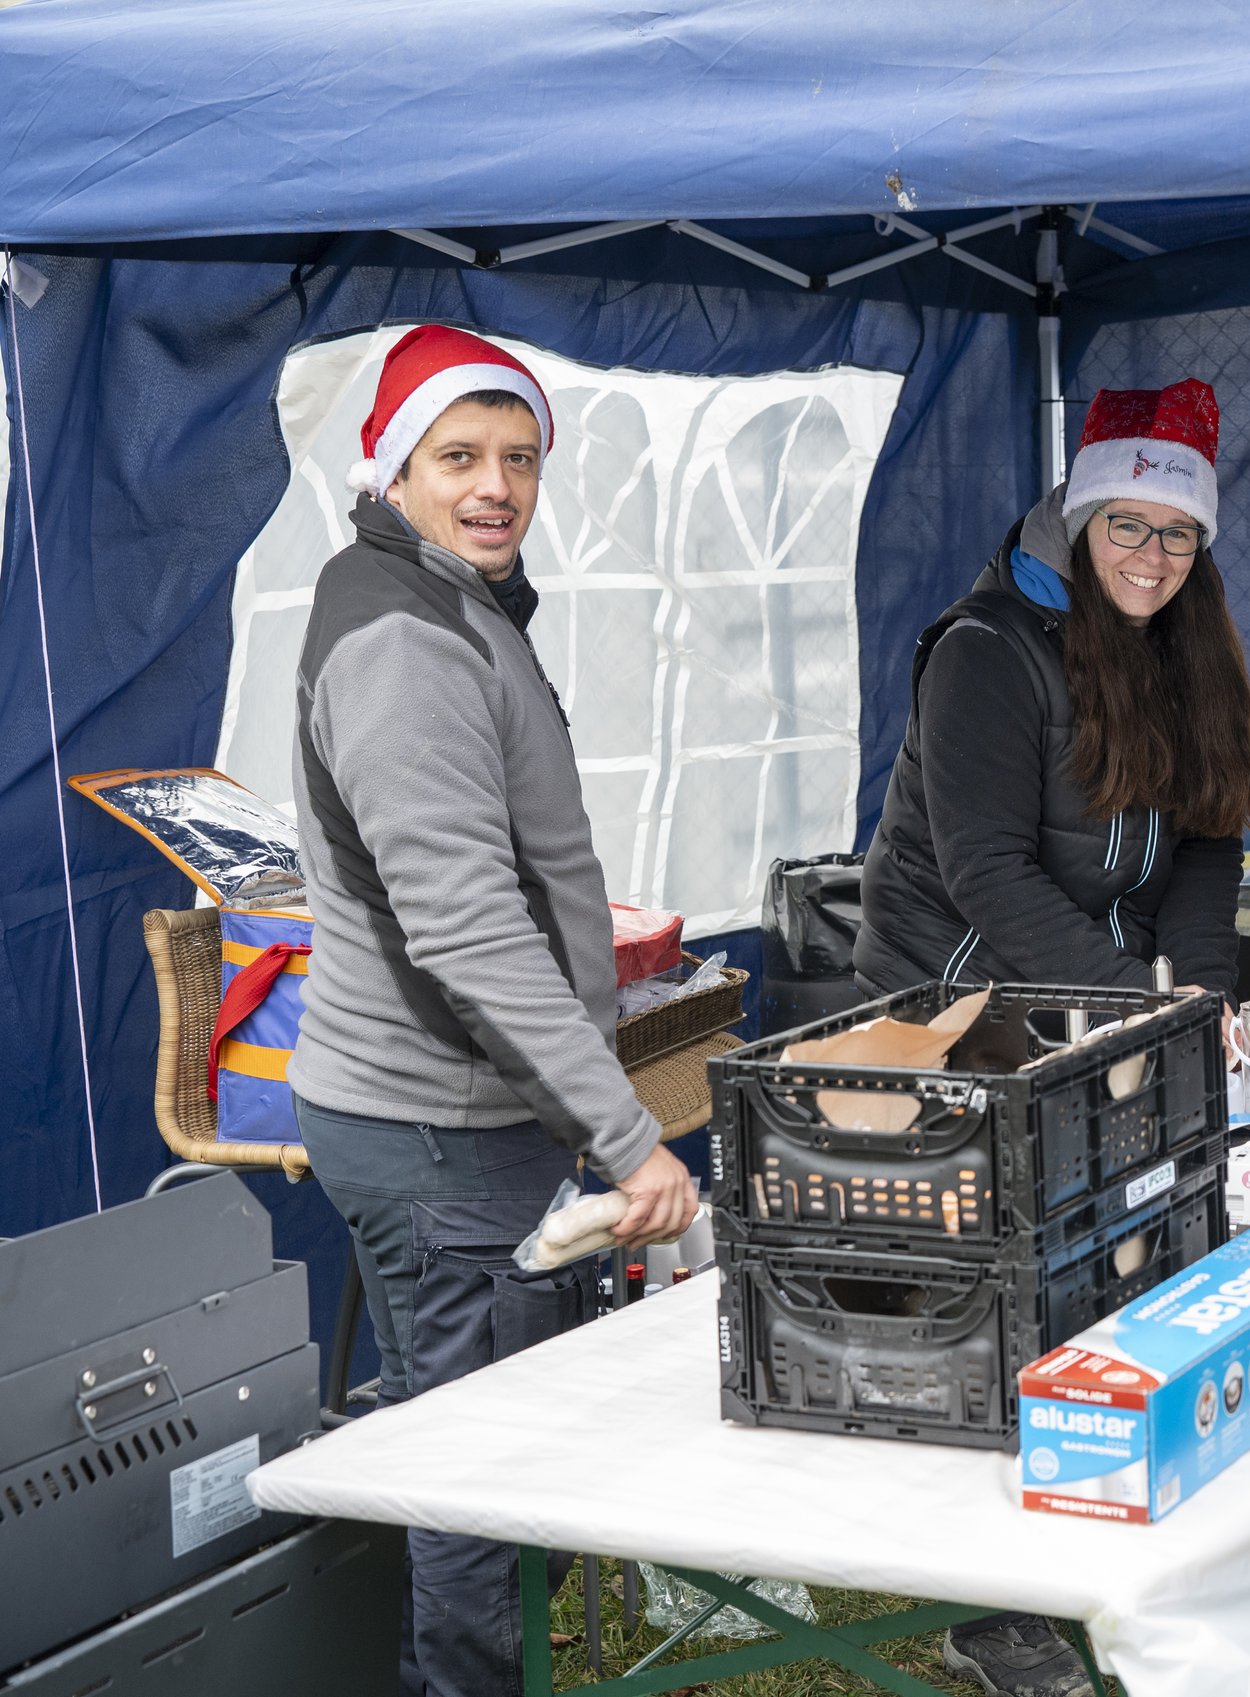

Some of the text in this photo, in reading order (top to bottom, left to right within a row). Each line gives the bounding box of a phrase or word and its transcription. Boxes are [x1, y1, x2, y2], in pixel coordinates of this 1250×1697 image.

[1066, 1388, 1113, 1404] SOLIDE
[1029, 1405, 1137, 1440] alustar
[1050, 1497, 1128, 1519] RESISTENTE
